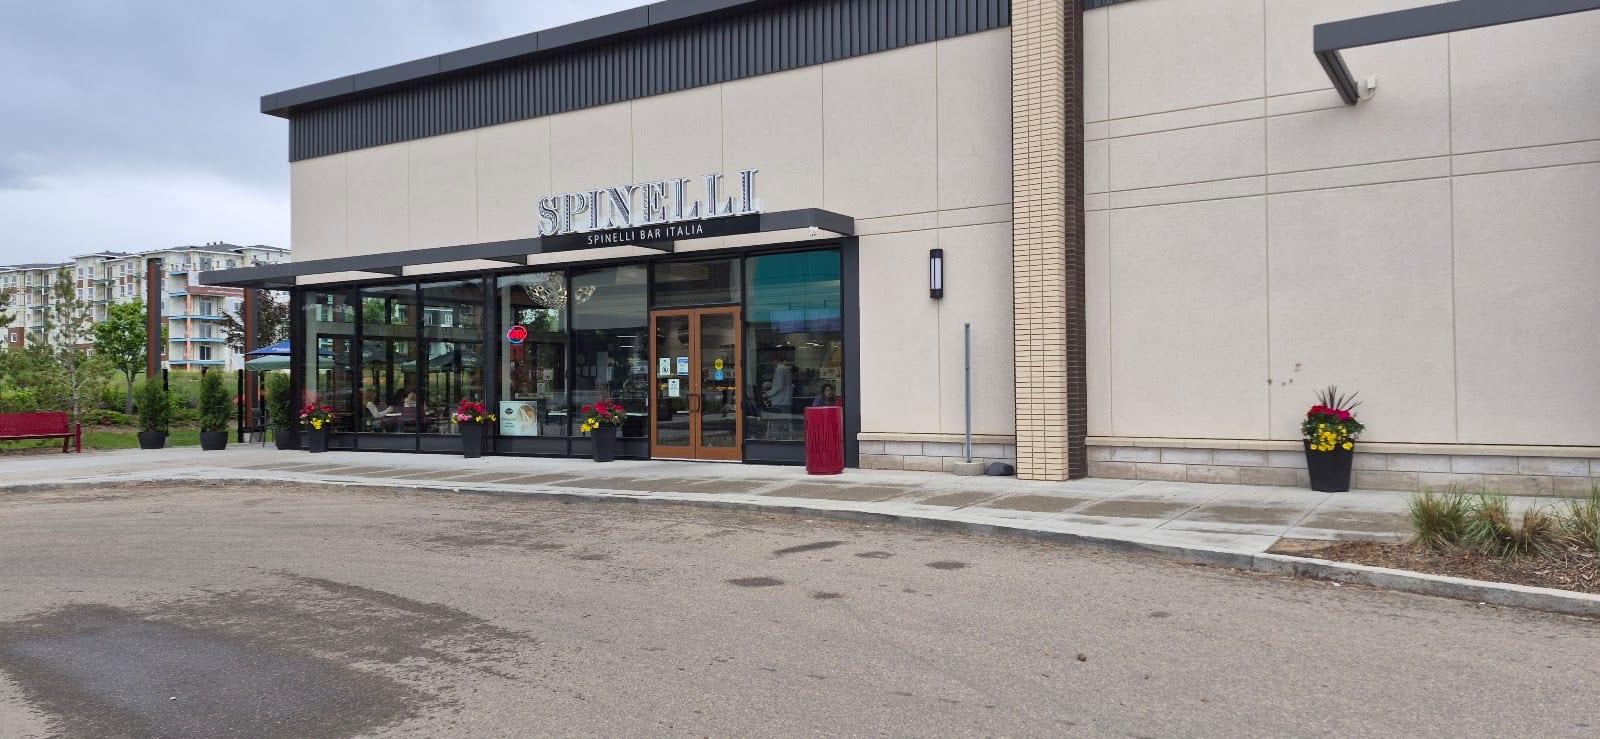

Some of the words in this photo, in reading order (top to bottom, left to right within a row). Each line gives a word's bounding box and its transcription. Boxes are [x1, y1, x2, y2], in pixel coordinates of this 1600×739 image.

[537, 168, 759, 236] SPINELLI
[587, 231, 635, 245] SPINELLI
[640, 228, 661, 240] BAR
[666, 223, 704, 238] ITALIA
